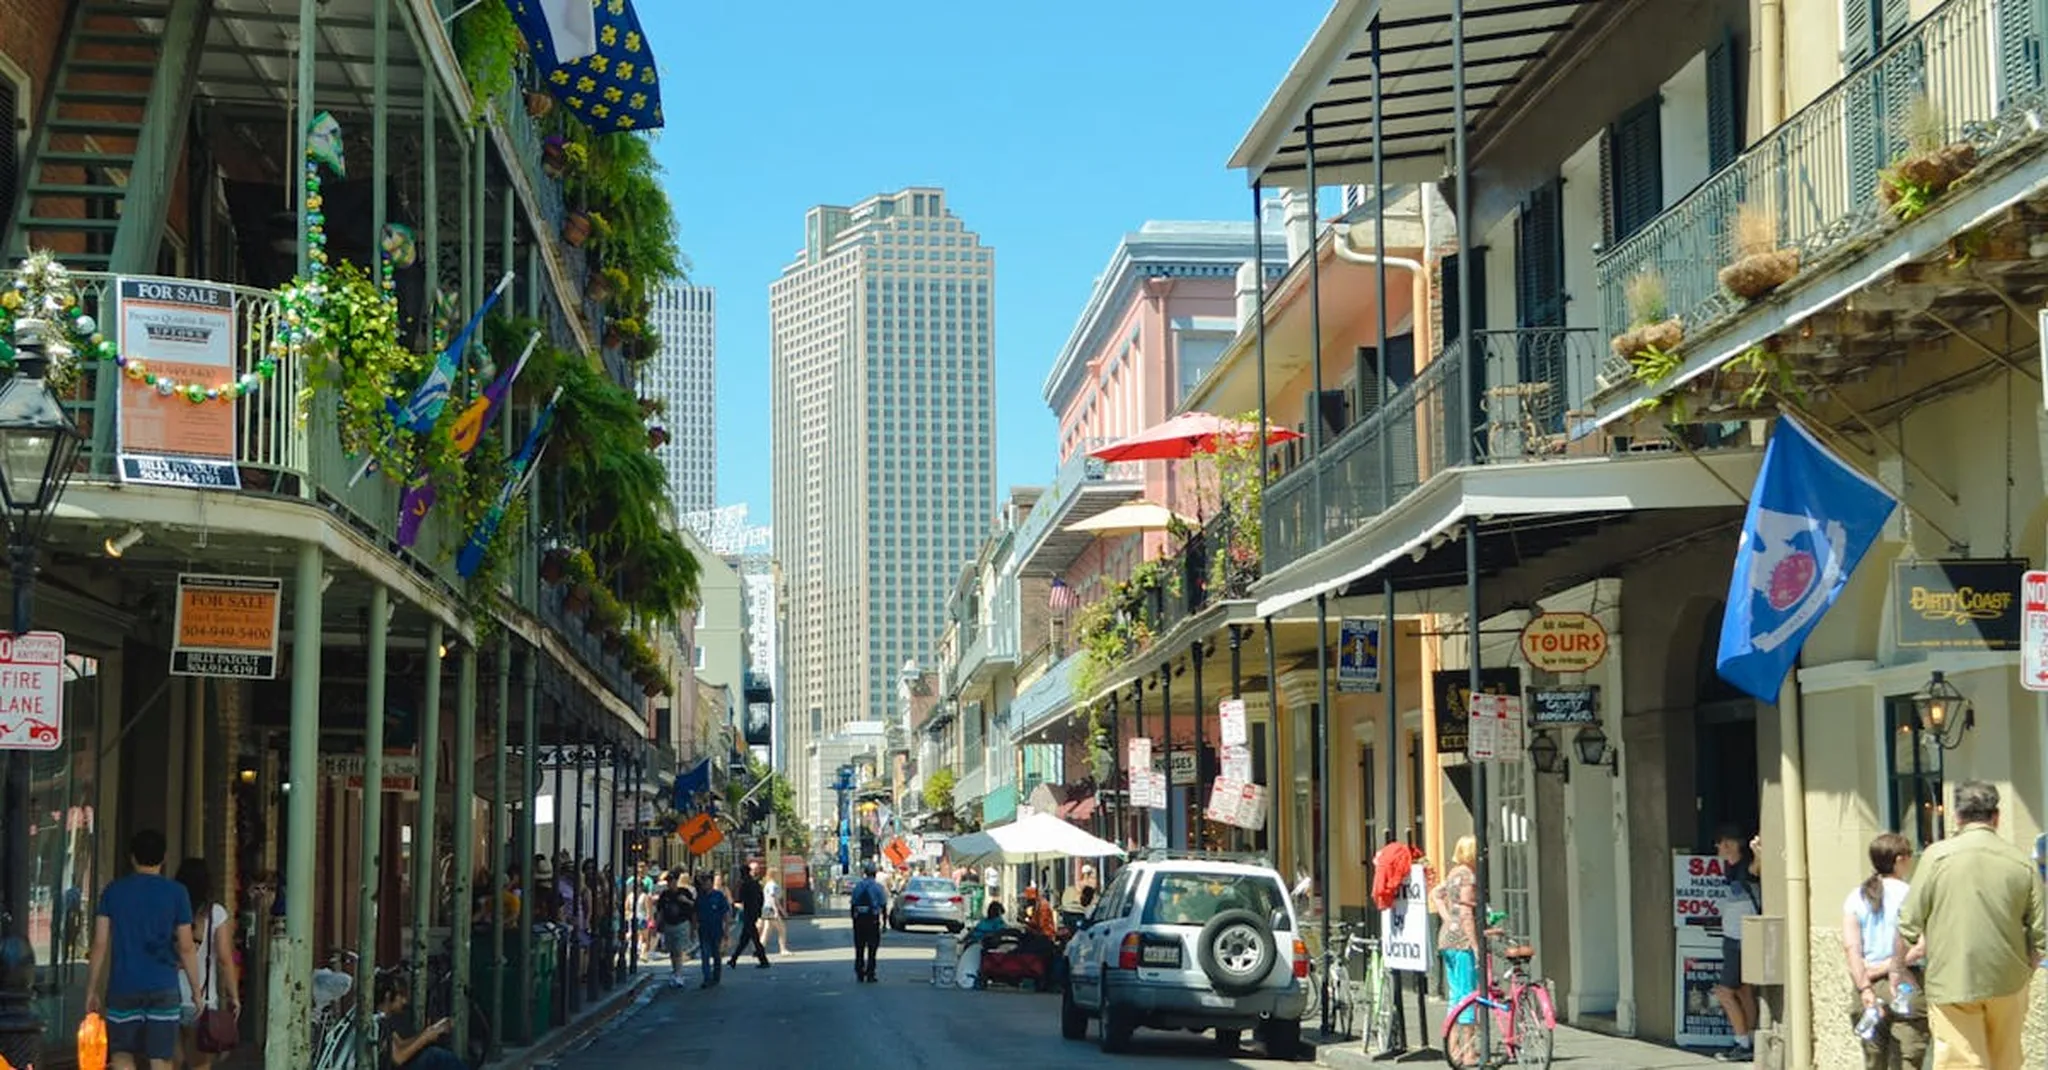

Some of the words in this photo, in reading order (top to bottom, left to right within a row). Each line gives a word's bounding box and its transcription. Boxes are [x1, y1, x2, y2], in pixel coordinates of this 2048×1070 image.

[138, 283, 173, 299] FOR
[177, 286, 219, 304] SALE
[191, 594, 222, 607] FOR
[227, 595, 267, 609] SALE
[1528, 633, 1601, 653] TOURS
[2, 671, 42, 690] FIRE
[0, 695, 44, 714] LANE
[1677, 899, 1719, 916] 50%
